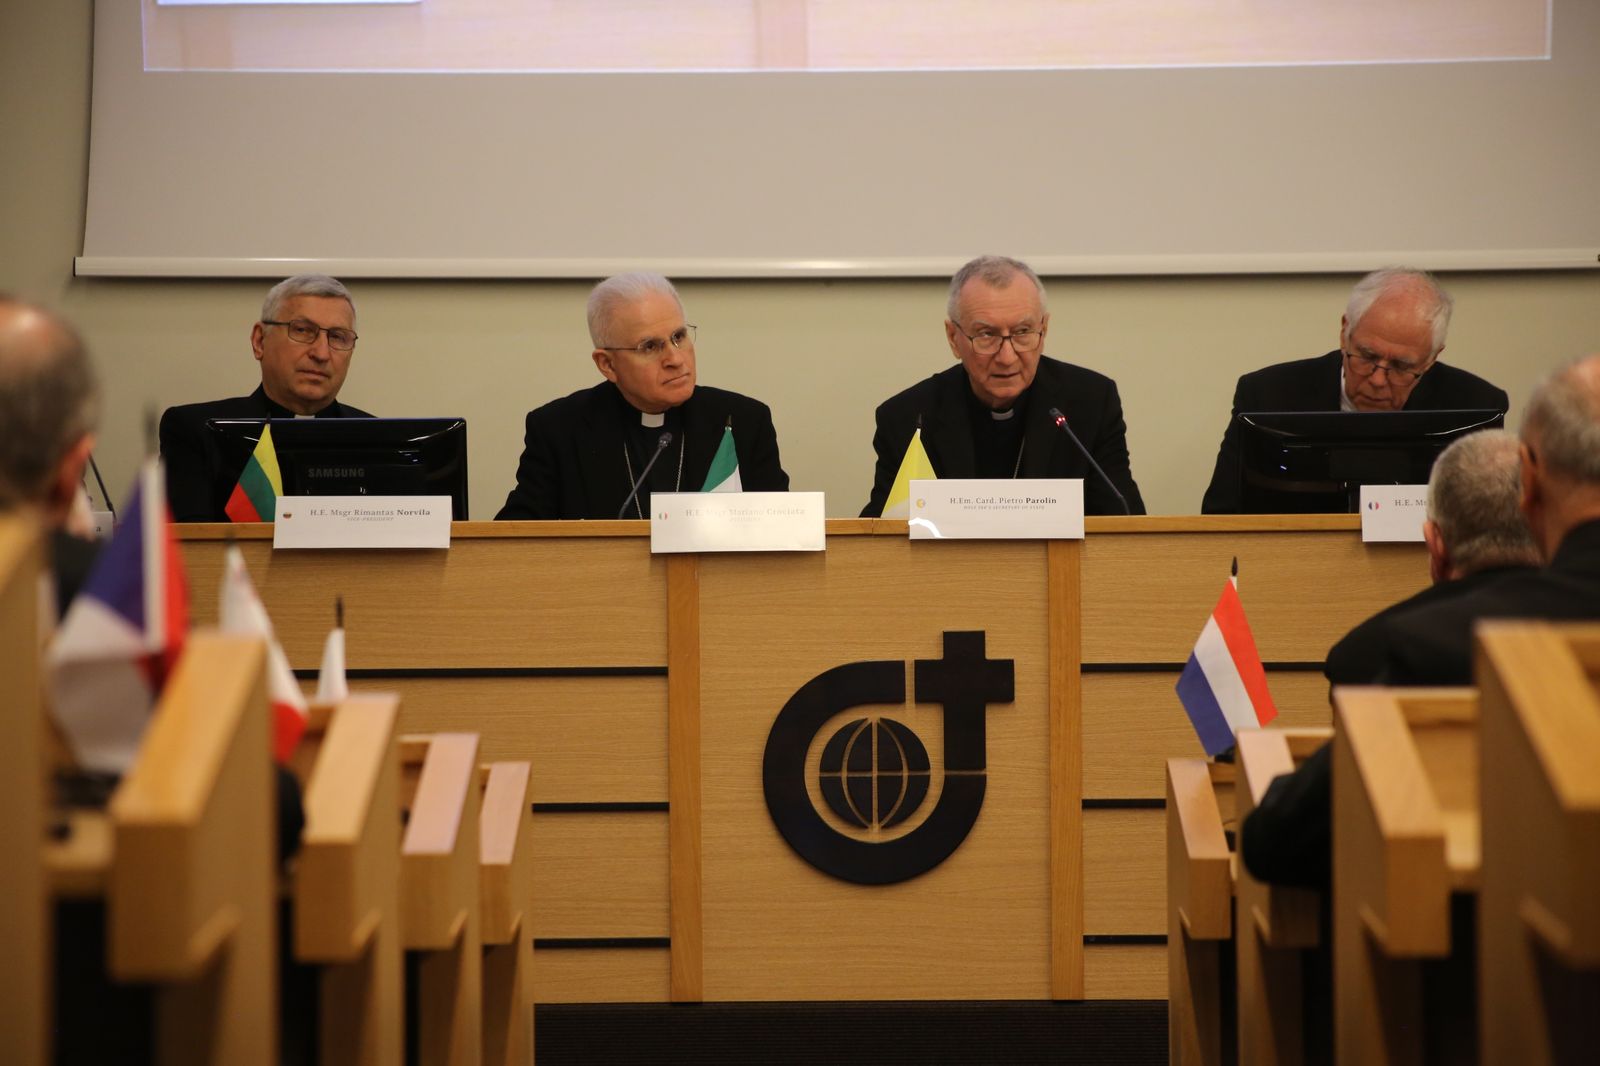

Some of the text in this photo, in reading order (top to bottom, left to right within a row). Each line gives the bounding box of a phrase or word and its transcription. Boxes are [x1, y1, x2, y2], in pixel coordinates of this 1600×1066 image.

[308, 467, 365, 478] SAMSUNG
[1394, 499, 1413, 507] H.E.
[330, 509, 352, 518] Msgr
[396, 508, 431, 516] Norvila
